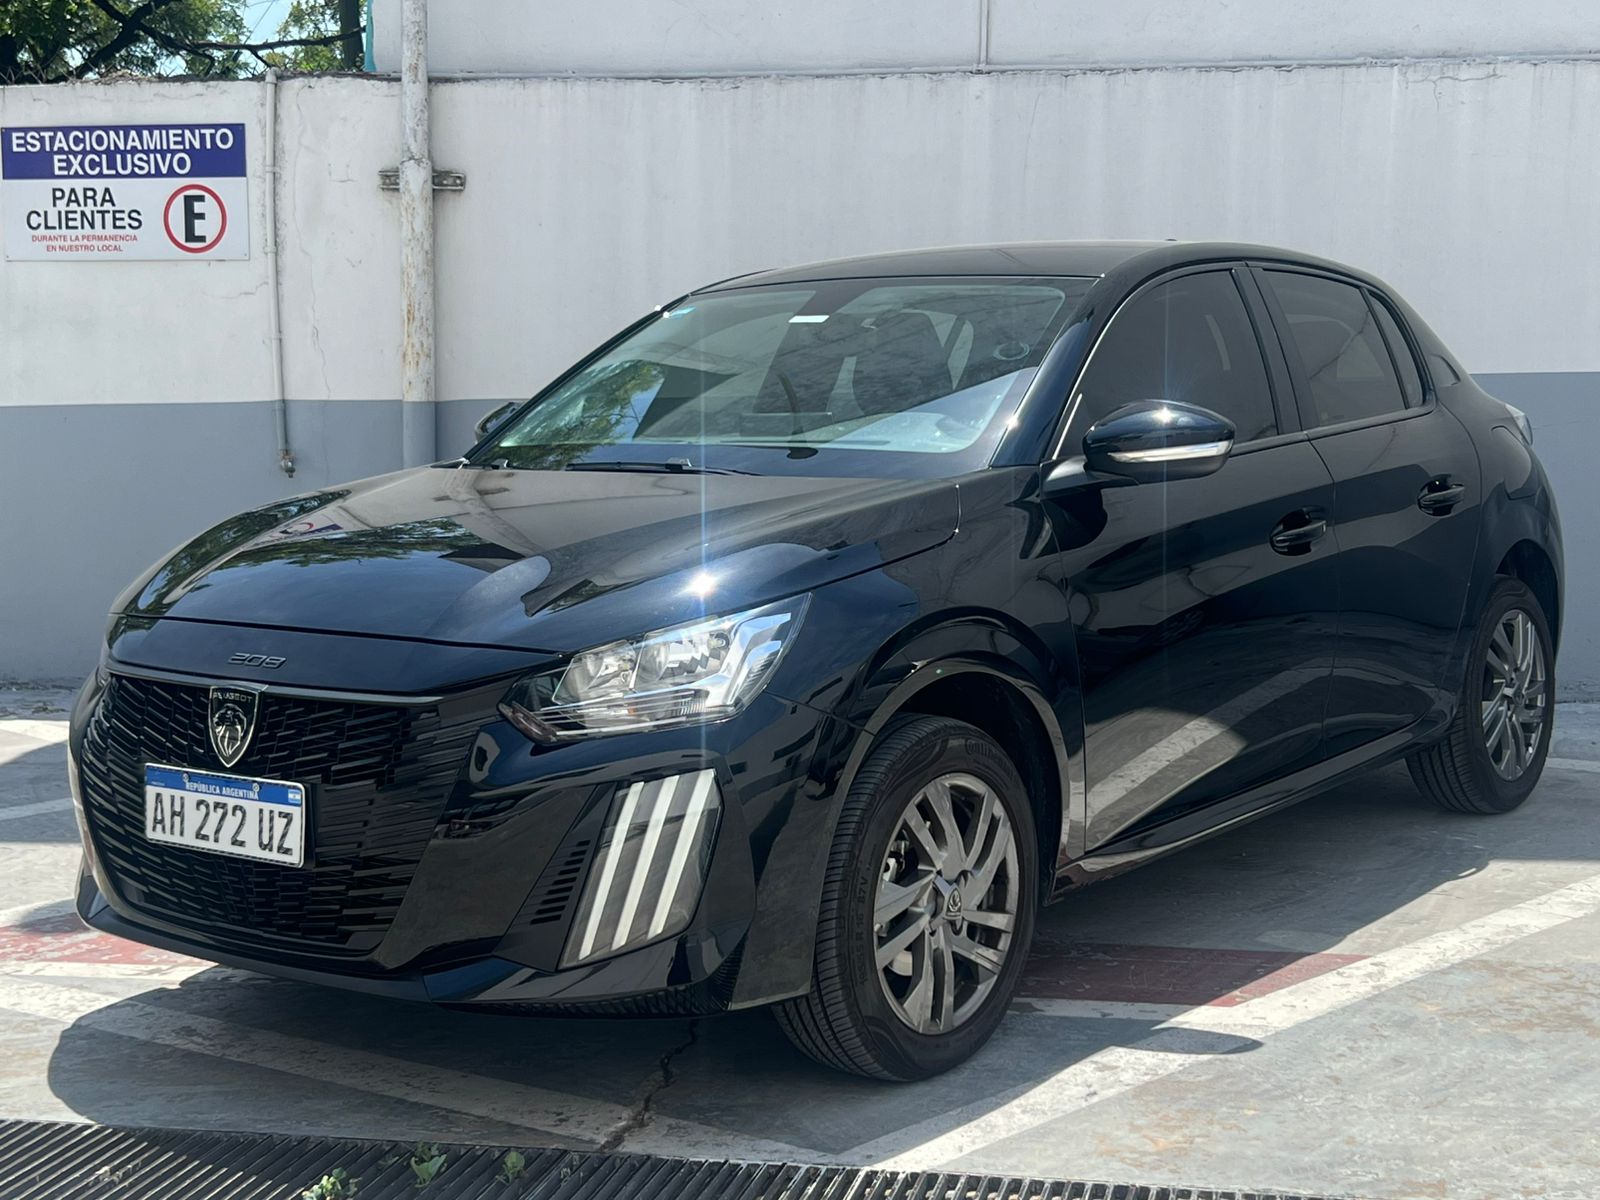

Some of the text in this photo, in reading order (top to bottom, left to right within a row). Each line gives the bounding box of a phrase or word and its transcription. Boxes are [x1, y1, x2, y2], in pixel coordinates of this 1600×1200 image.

[11, 128, 234, 152] ESTACIONAMIENTO
[53, 152, 192, 176] EXCLUSIVO
[51, 187, 116, 208] PARA
[26, 209, 143, 230] CLIENTES
[183, 194, 207, 243] E
[31, 234, 138, 242] DURANTE LA PERMANENCIA
[46, 244, 124, 252] EN NUESTRO LOCAL
[228, 652, 287, 669] 208
[185, 781, 259, 800] REPÚBLICA ARGENTINA
[152, 792, 294, 856] AH 272 UZ
